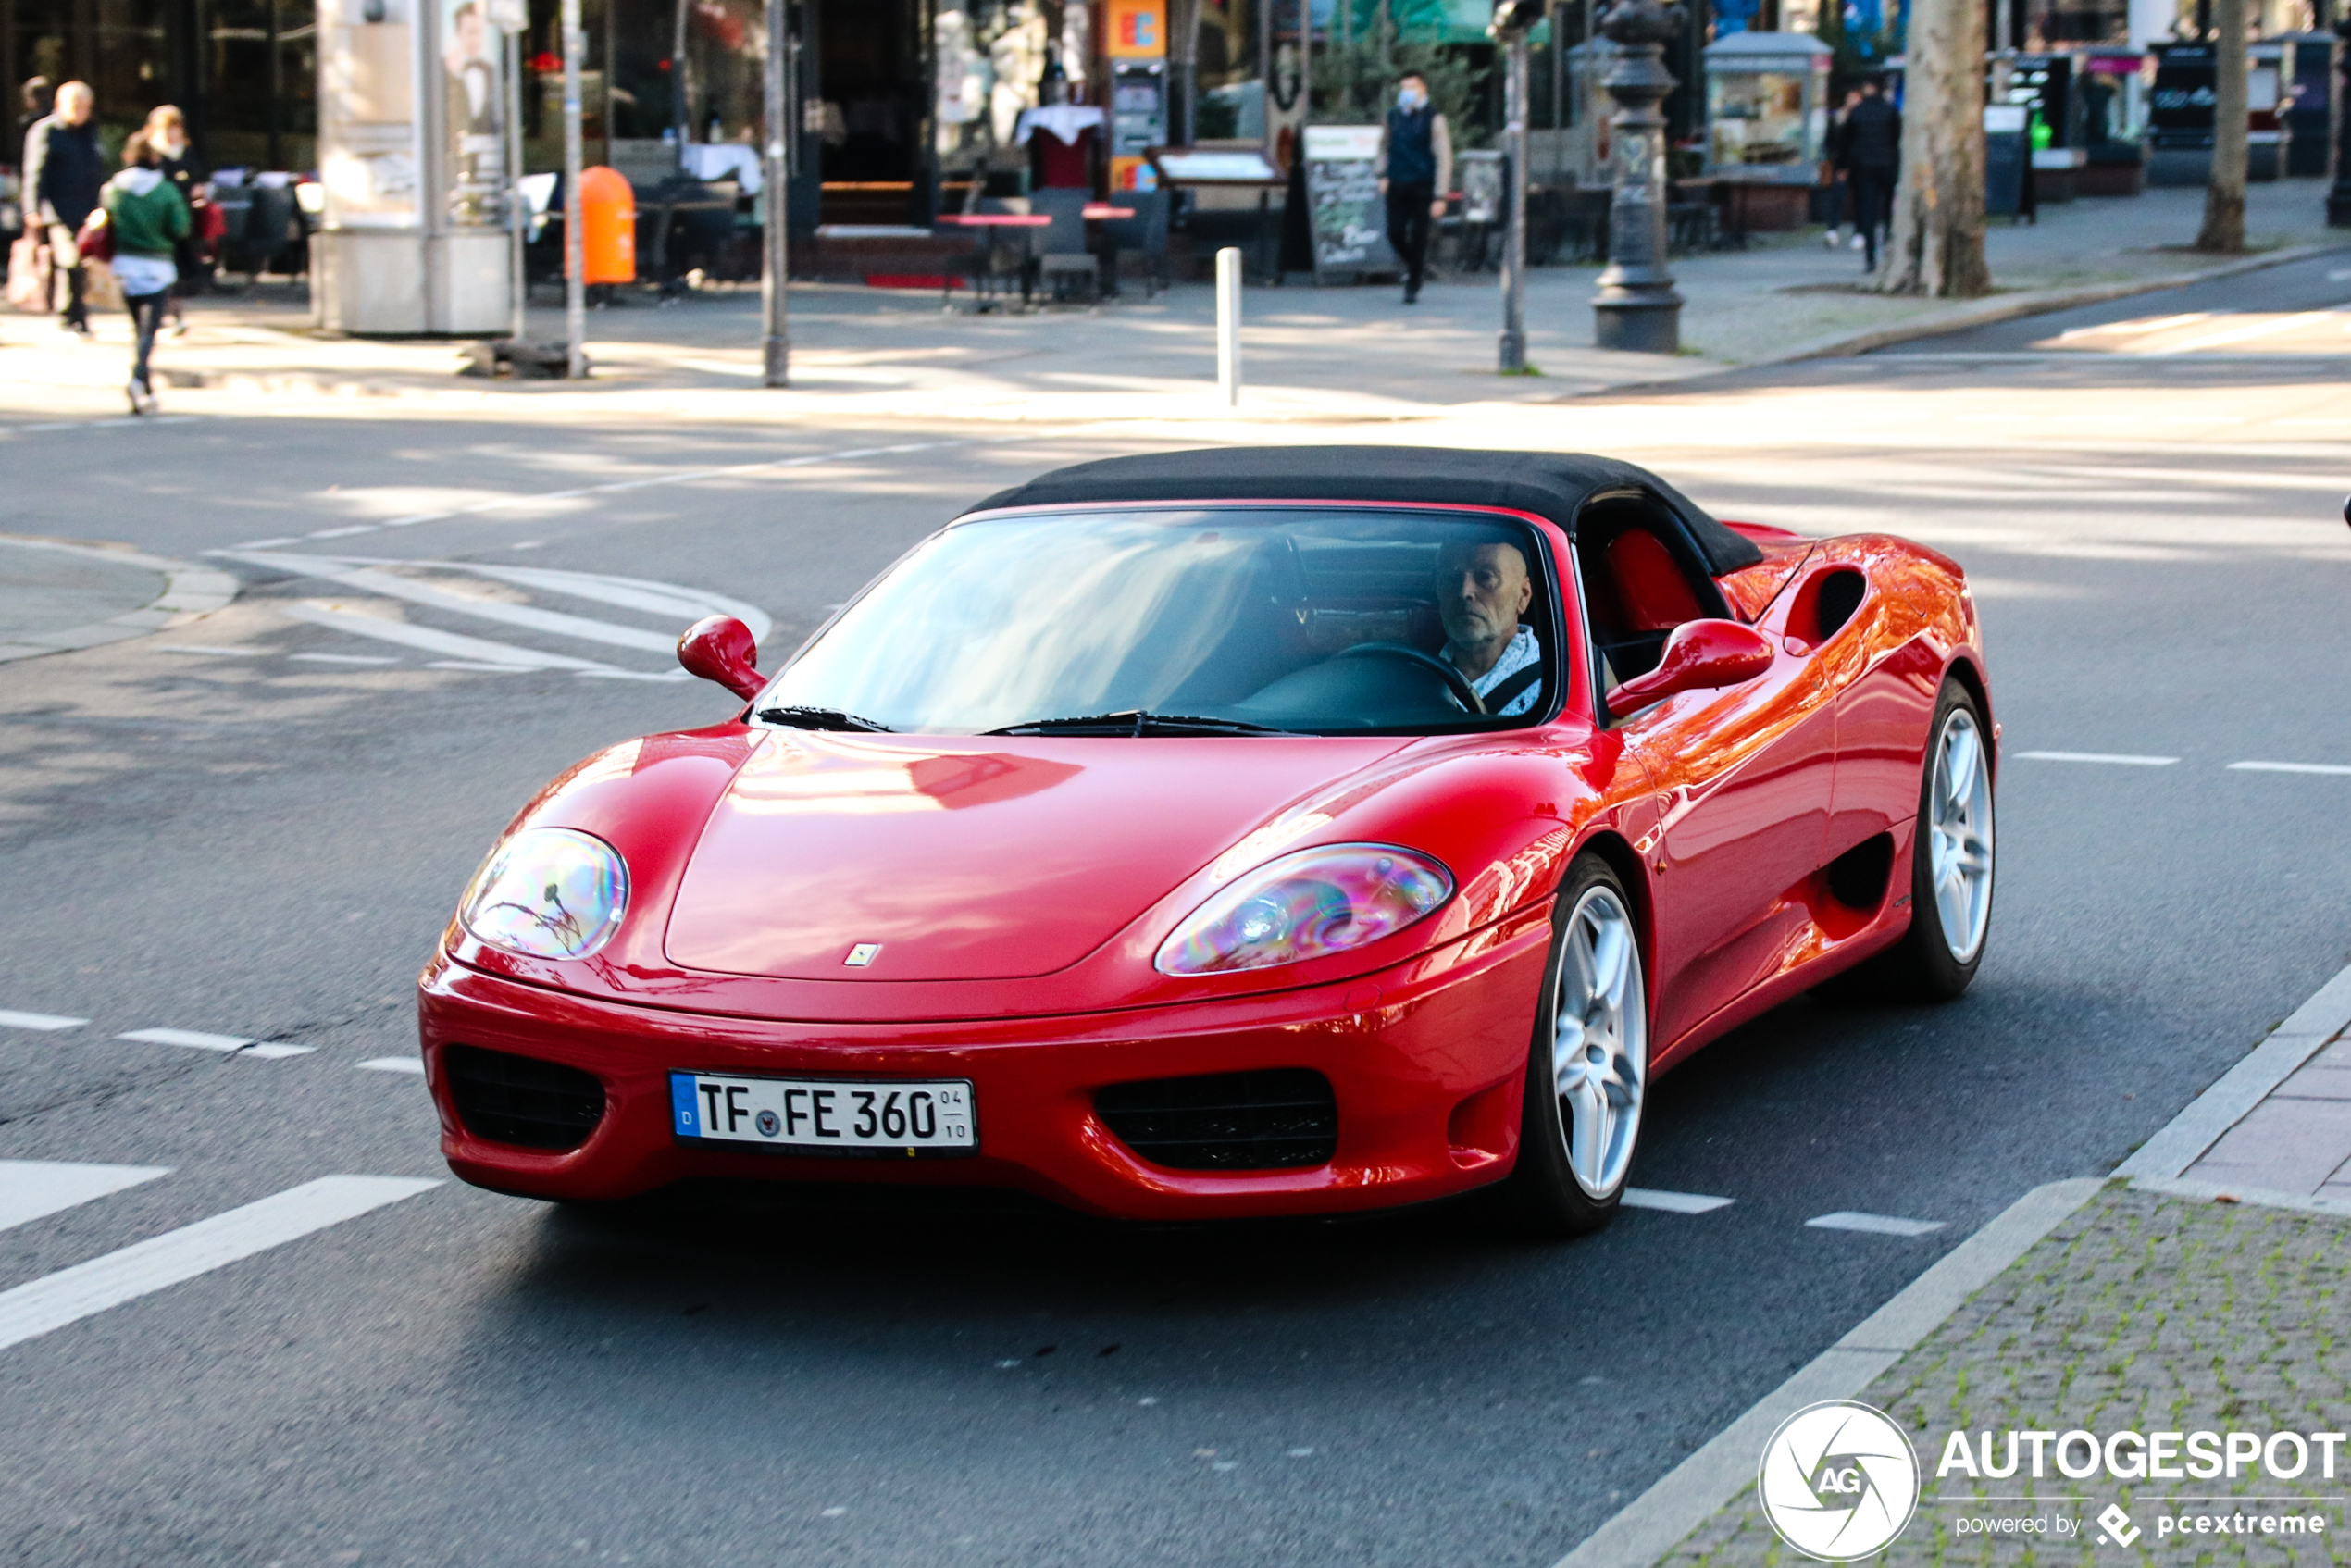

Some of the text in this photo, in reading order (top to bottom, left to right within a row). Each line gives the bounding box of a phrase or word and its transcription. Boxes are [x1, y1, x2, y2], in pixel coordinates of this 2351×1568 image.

[1120, 12, 1155, 46] EC
[940, 1090, 962, 1104] 04
[681, 1111, 692, 1126] D
[699, 1083, 936, 1139] TF FE 360
[946, 1125, 965, 1139] 10
